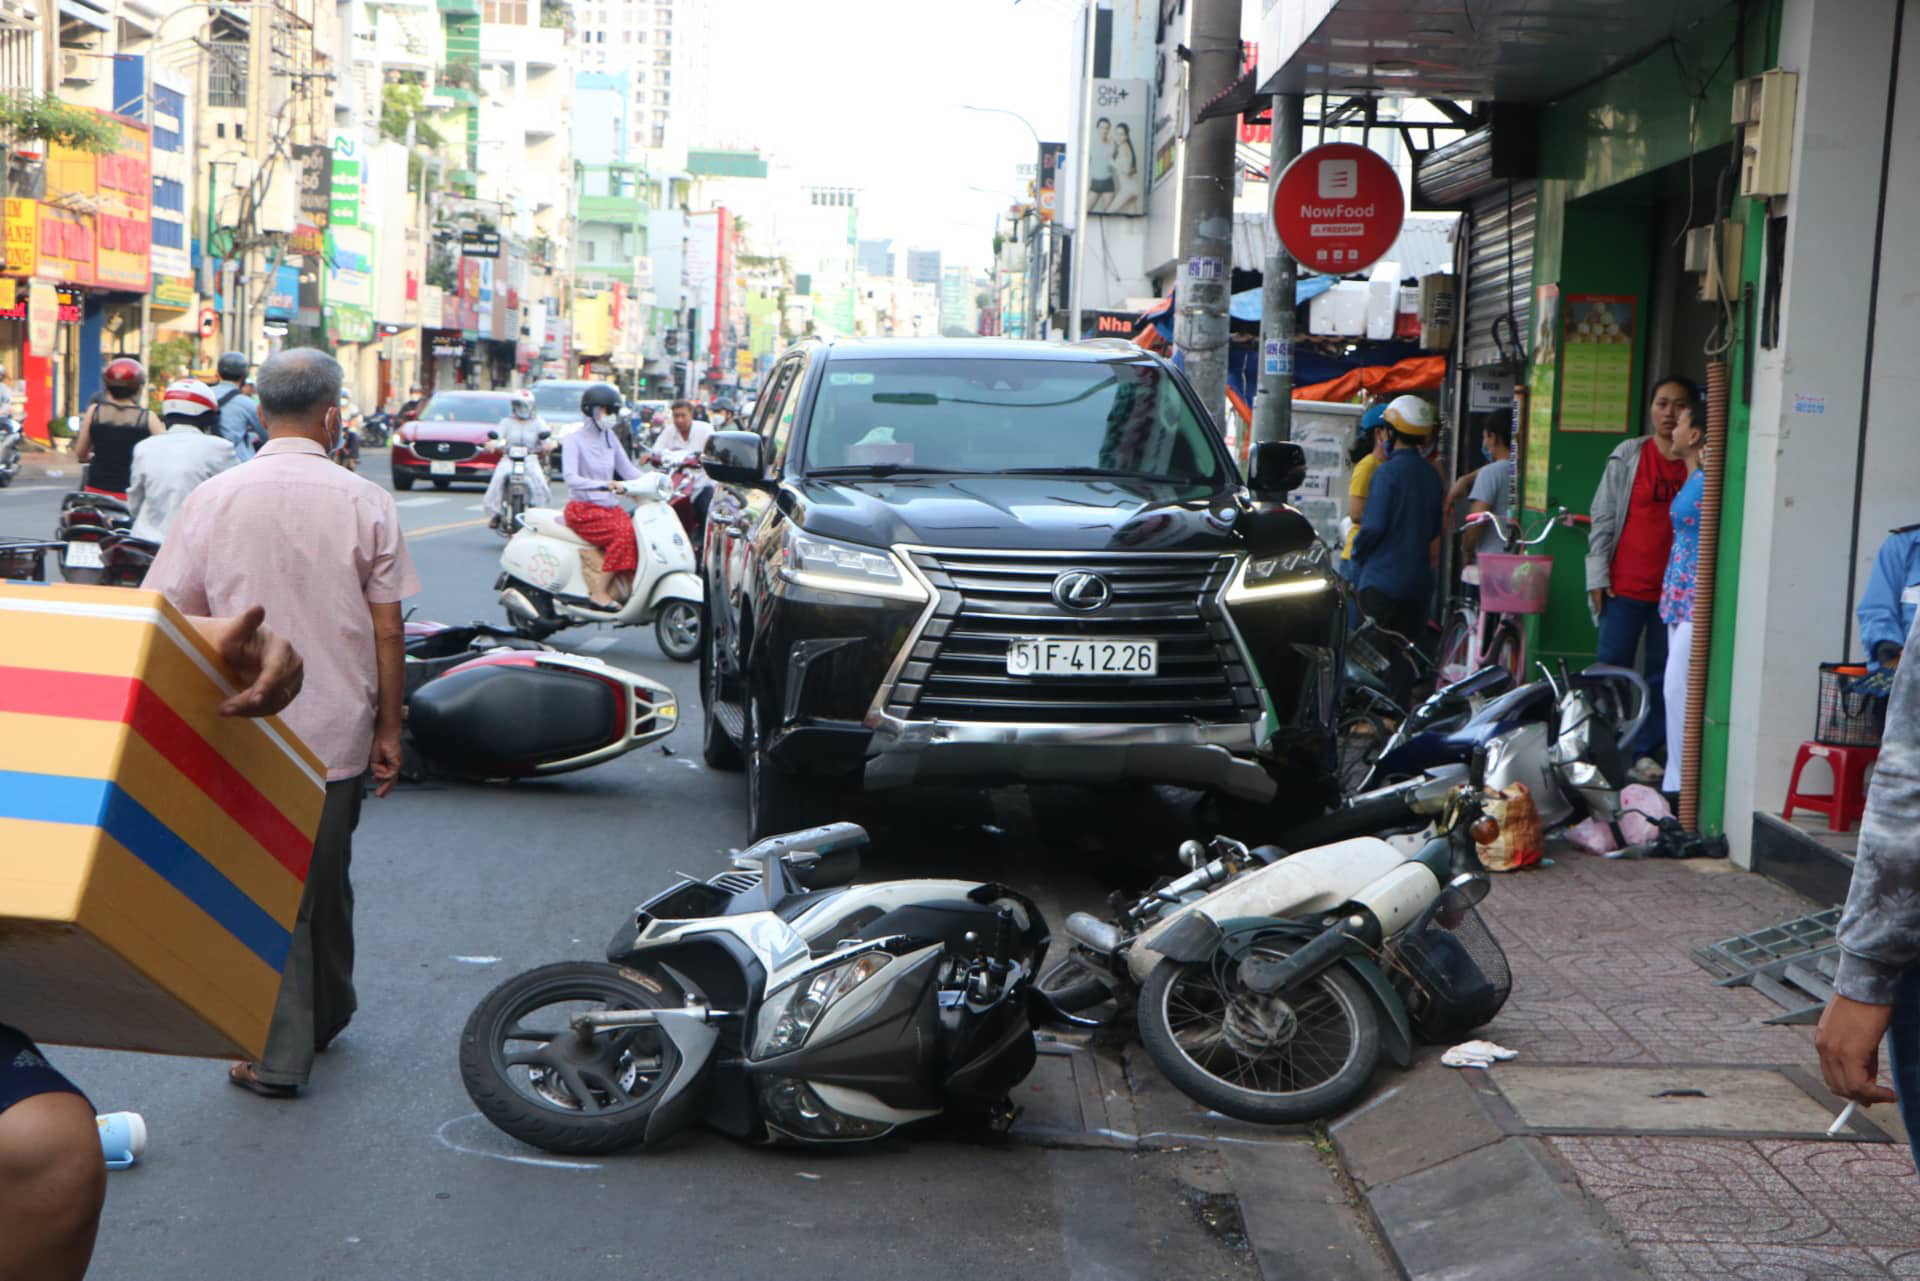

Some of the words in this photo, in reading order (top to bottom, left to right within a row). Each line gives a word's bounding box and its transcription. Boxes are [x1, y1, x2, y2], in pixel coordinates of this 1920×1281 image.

[1098, 85, 1117, 96] ON
[1097, 96, 1119, 107] OFF
[1300, 203, 1375, 217] NowFood
[1098, 316, 1132, 332] Nha
[1016, 644, 1152, 672] 51F-412.26
